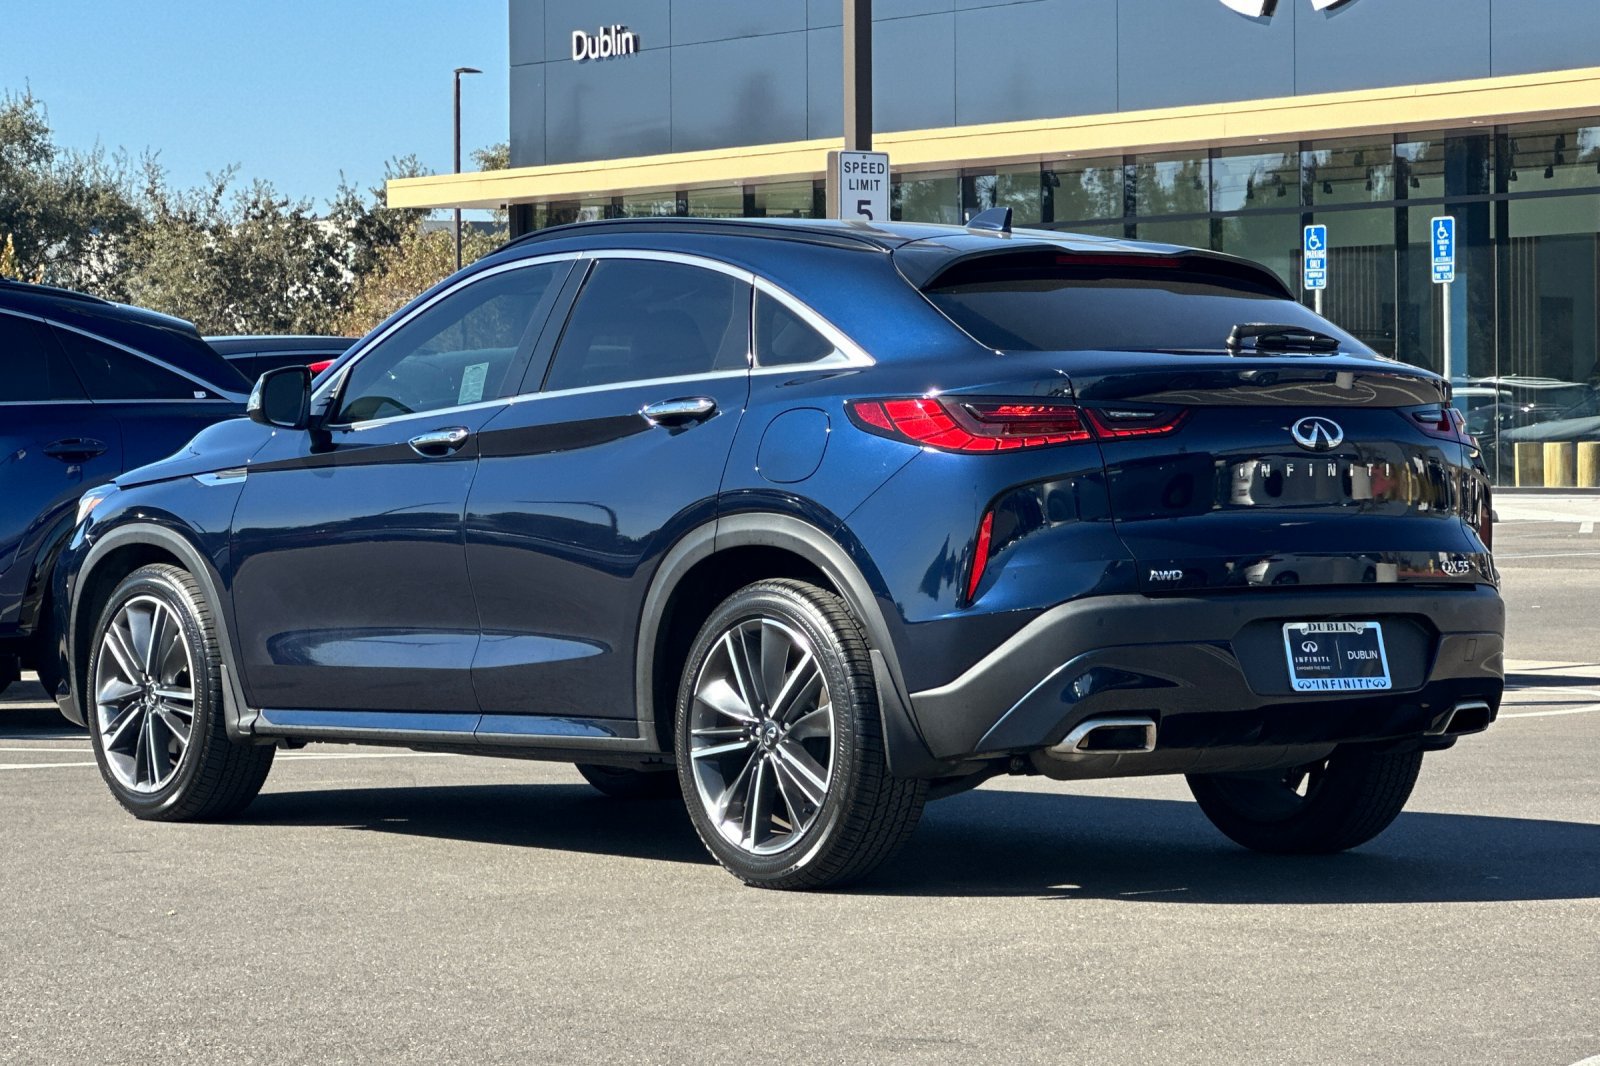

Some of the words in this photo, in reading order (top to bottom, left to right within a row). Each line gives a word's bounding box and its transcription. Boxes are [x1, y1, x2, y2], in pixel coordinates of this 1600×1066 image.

[571, 24, 634, 61] Dublin
[844, 161, 885, 175] SPEED
[848, 178, 881, 191] LIMIT
[856, 199, 874, 221] 5
[1306, 249, 1325, 259] PARKING
[1309, 259, 1321, 269] ONLY
[1239, 463, 1390, 477] INFINITI
[1441, 560, 1470, 576] QX55
[1149, 569, 1184, 581] AWD
[1308, 623, 1356, 631] DUBLIN
[1347, 650, 1378, 660] DUBLIN
[1316, 679, 1369, 689] INFINITI
